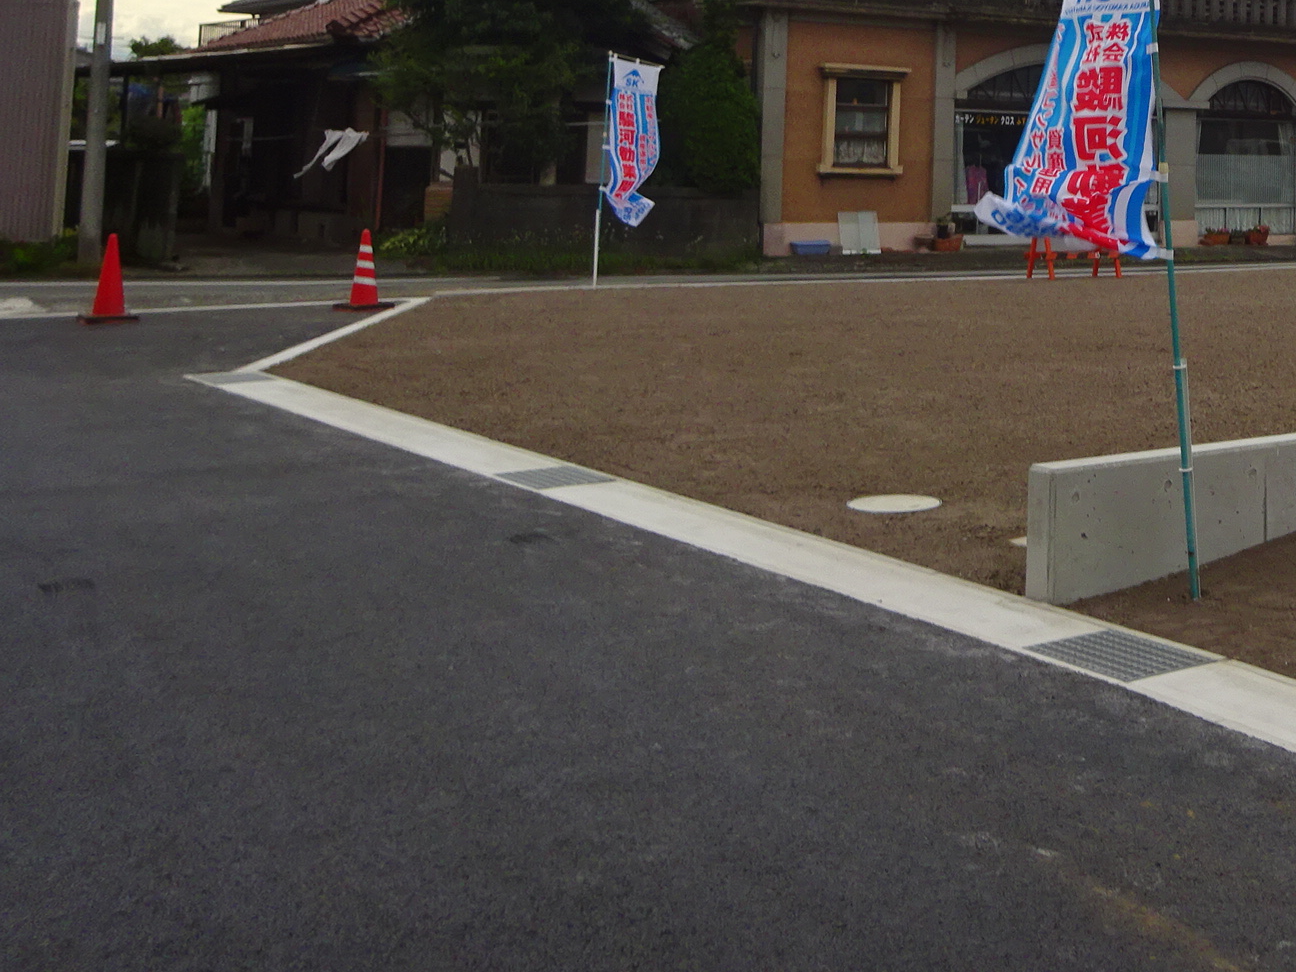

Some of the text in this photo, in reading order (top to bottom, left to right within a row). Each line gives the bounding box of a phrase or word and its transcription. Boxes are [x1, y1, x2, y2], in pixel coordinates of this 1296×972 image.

[625, 78, 639, 87] SK
[955, 113, 975, 124] カーテン
[1000, 115, 1015, 126] クロス
[1016, 116, 1027, 125] ふす
